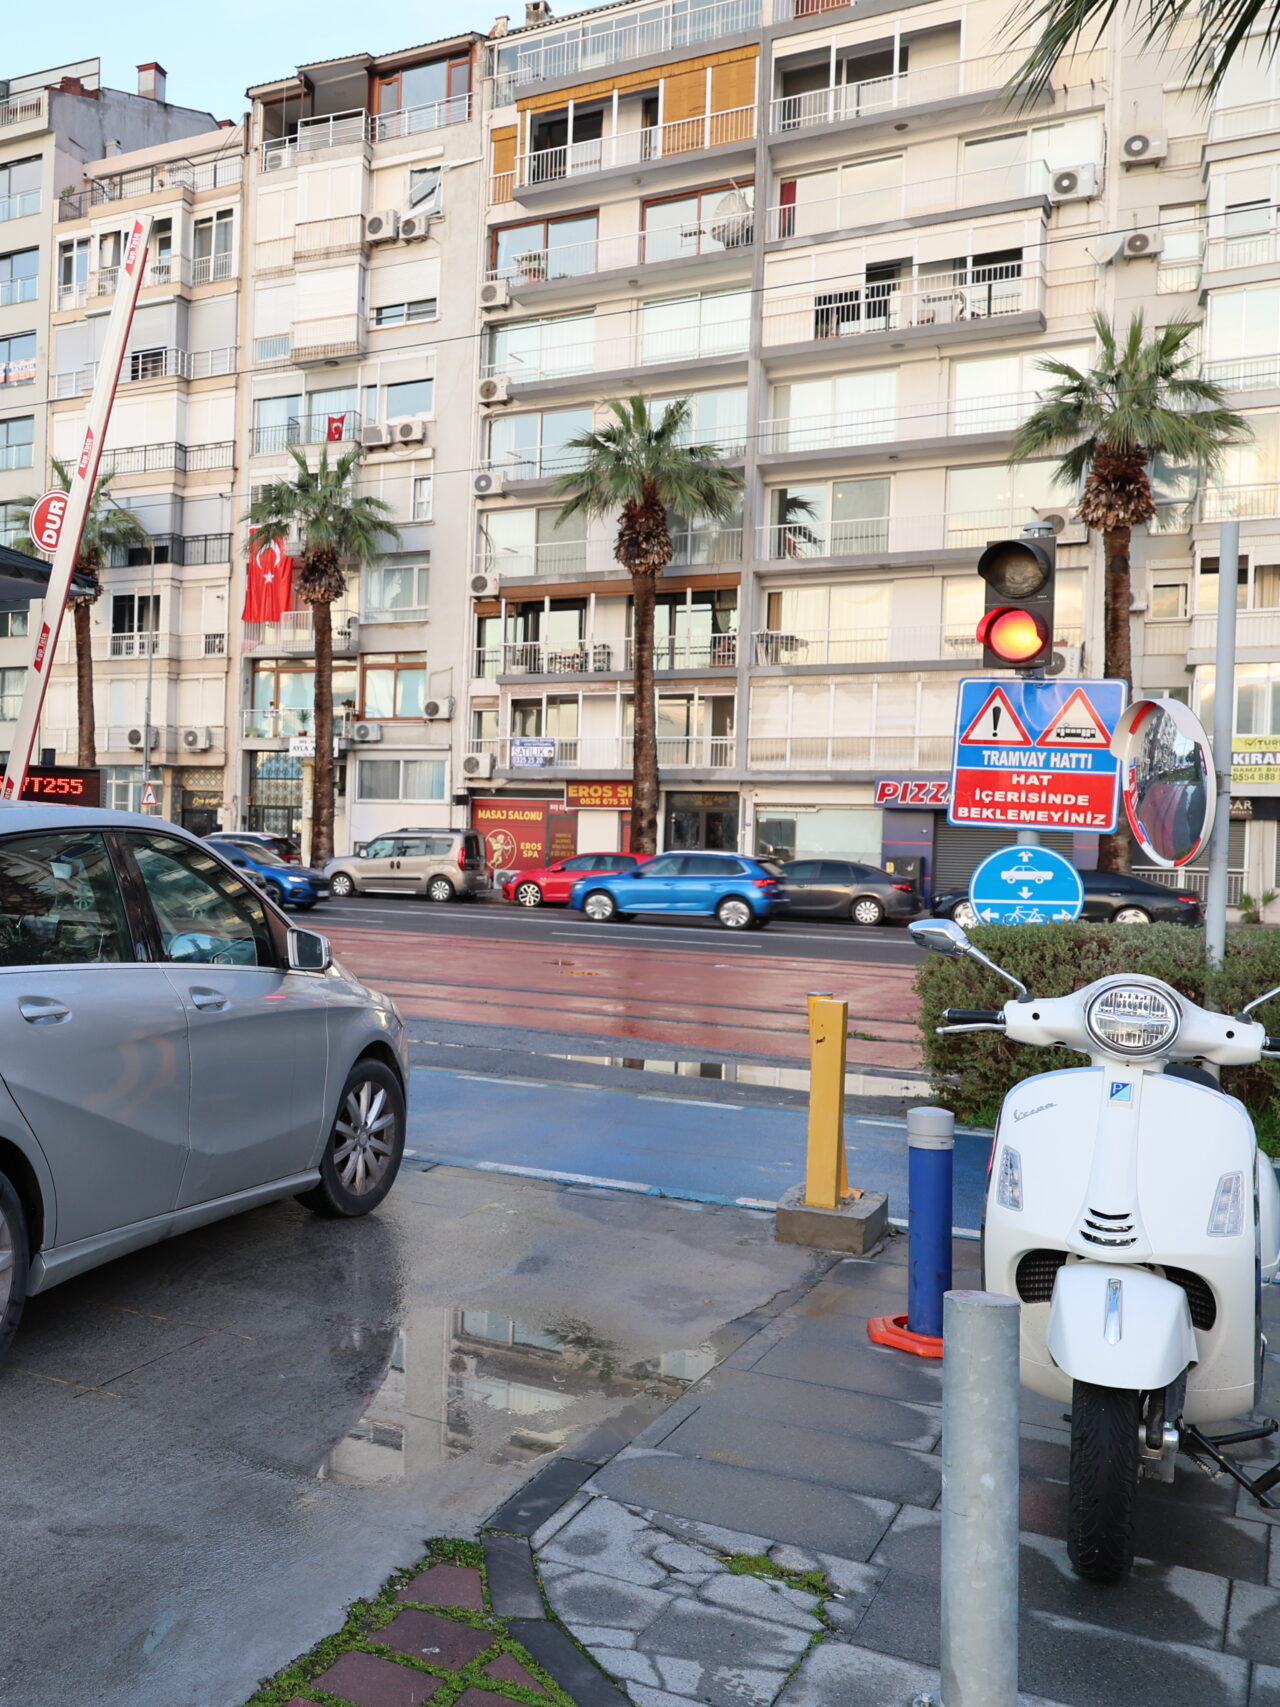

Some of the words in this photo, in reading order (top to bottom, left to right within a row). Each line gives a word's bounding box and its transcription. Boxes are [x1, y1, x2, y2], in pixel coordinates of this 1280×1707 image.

[41, 500, 66, 545] DUR
[982, 750, 1045, 768] TRAMVAY
[1050, 754, 1093, 770] HATTI
[1011, 774, 1053, 787] HAT
[568, 785, 613, 797] EROS
[974, 788, 1090, 807] İÇERİSİNDE
[478, 809, 507, 820] MASAJ
[508, 810, 543, 821] SALONU
[957, 807, 1107, 826] BEKLEMEYİNİZ
[520, 842, 542, 851] EROS
[522, 850, 539, 858] SPA
